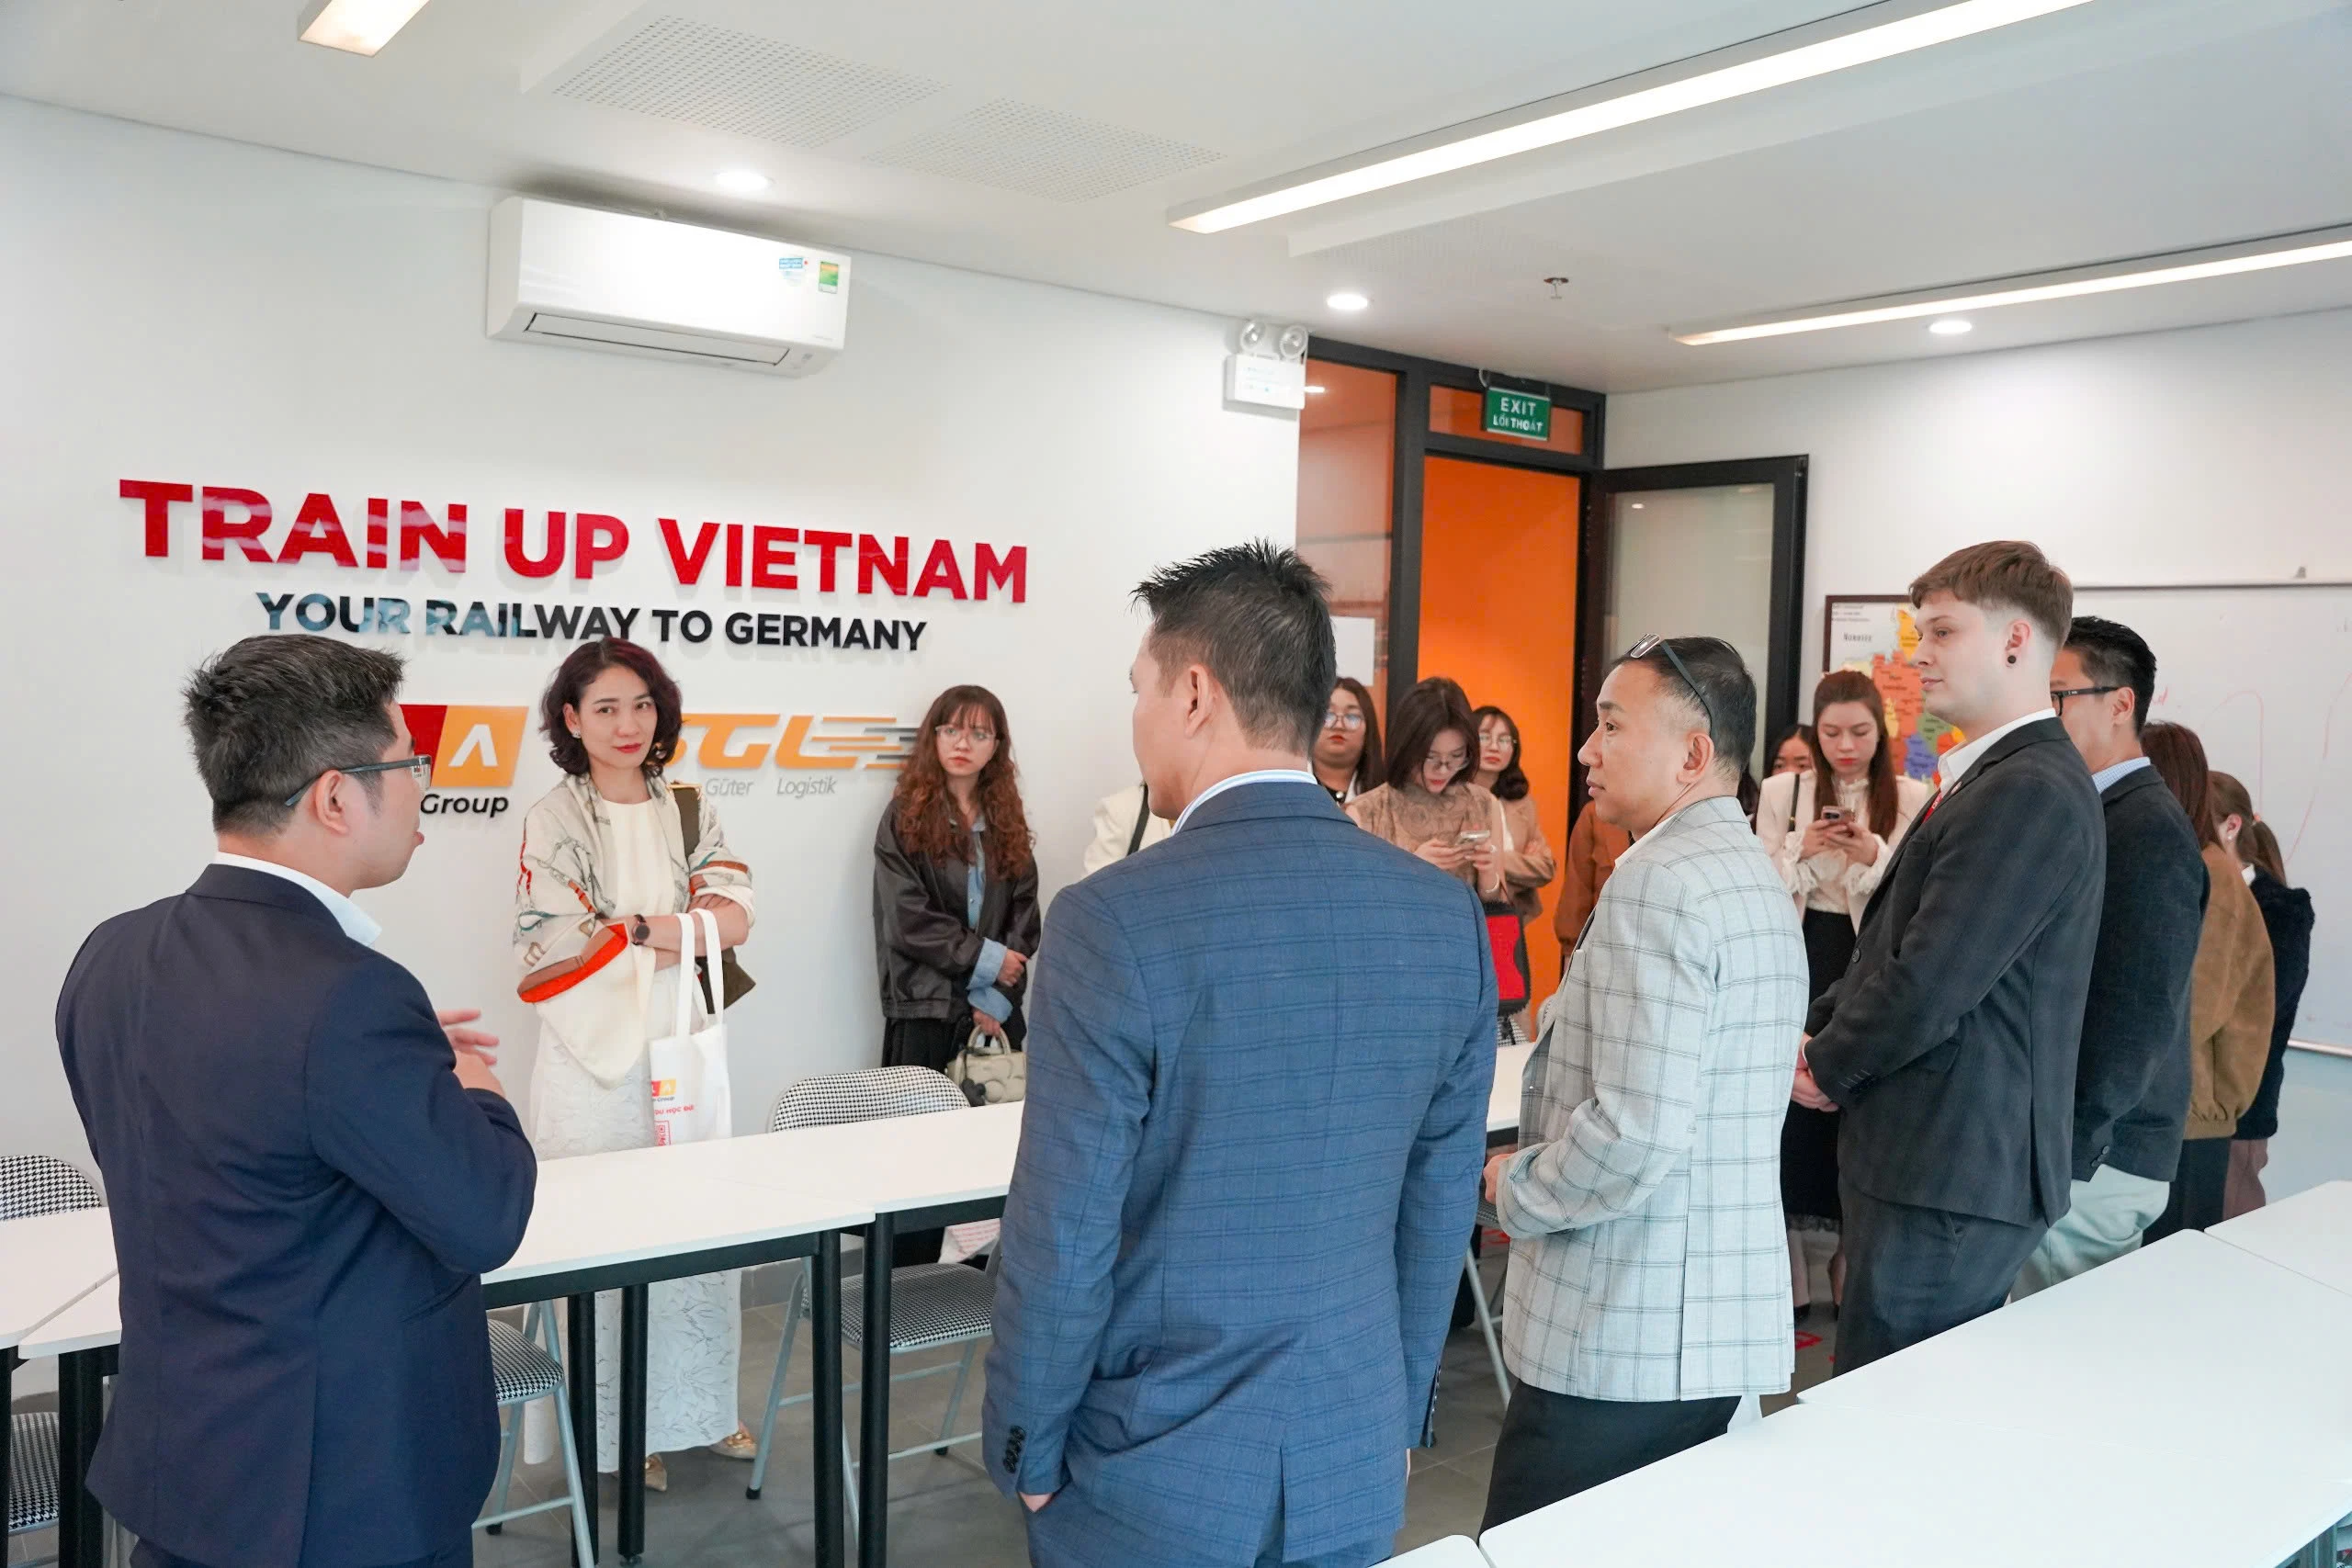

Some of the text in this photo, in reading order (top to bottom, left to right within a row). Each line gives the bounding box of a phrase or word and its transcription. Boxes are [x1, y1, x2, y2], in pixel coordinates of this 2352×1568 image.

[1500, 397, 1536, 416] EXIT
[119, 479, 1027, 604] TRAIN UP VIETNAM
[255, 592, 927, 651] YOUR RAILWAY TO GERMANY
[706, 777, 836, 798] Güter Logistik
[421, 794, 509, 818] Group
